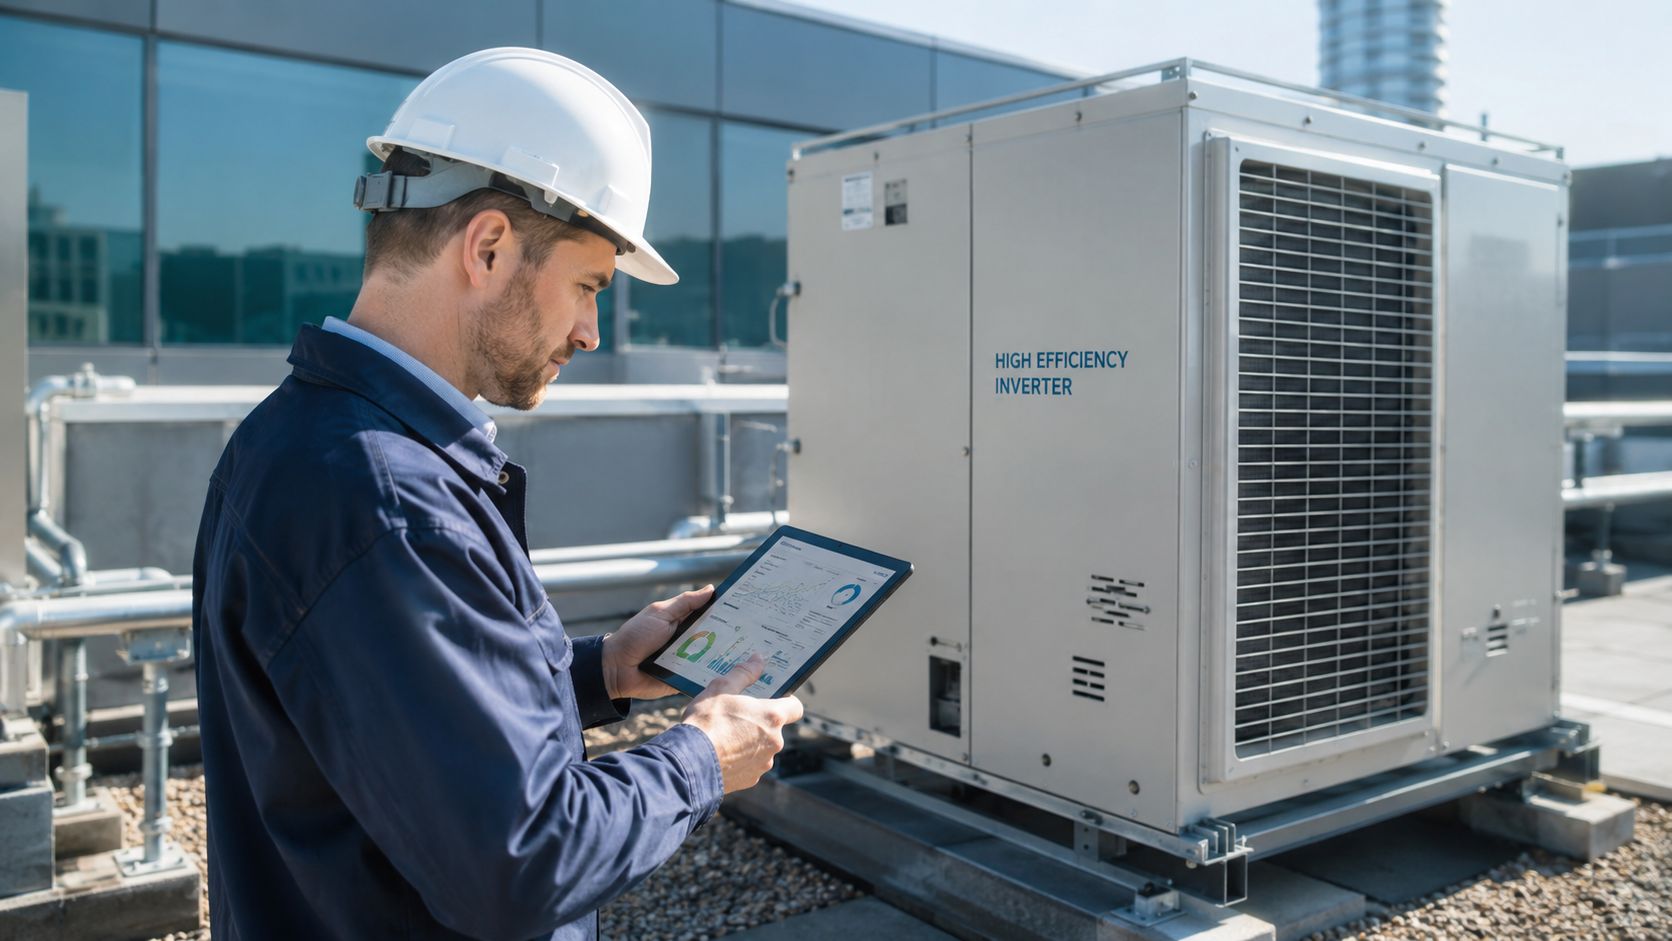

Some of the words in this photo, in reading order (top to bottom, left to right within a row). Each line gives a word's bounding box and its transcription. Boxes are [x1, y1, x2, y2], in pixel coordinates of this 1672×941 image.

[995, 352, 1031, 368] HIGH
[1037, 350, 1128, 368] EFFICIENCY
[995, 377, 1073, 395] INVERTER
